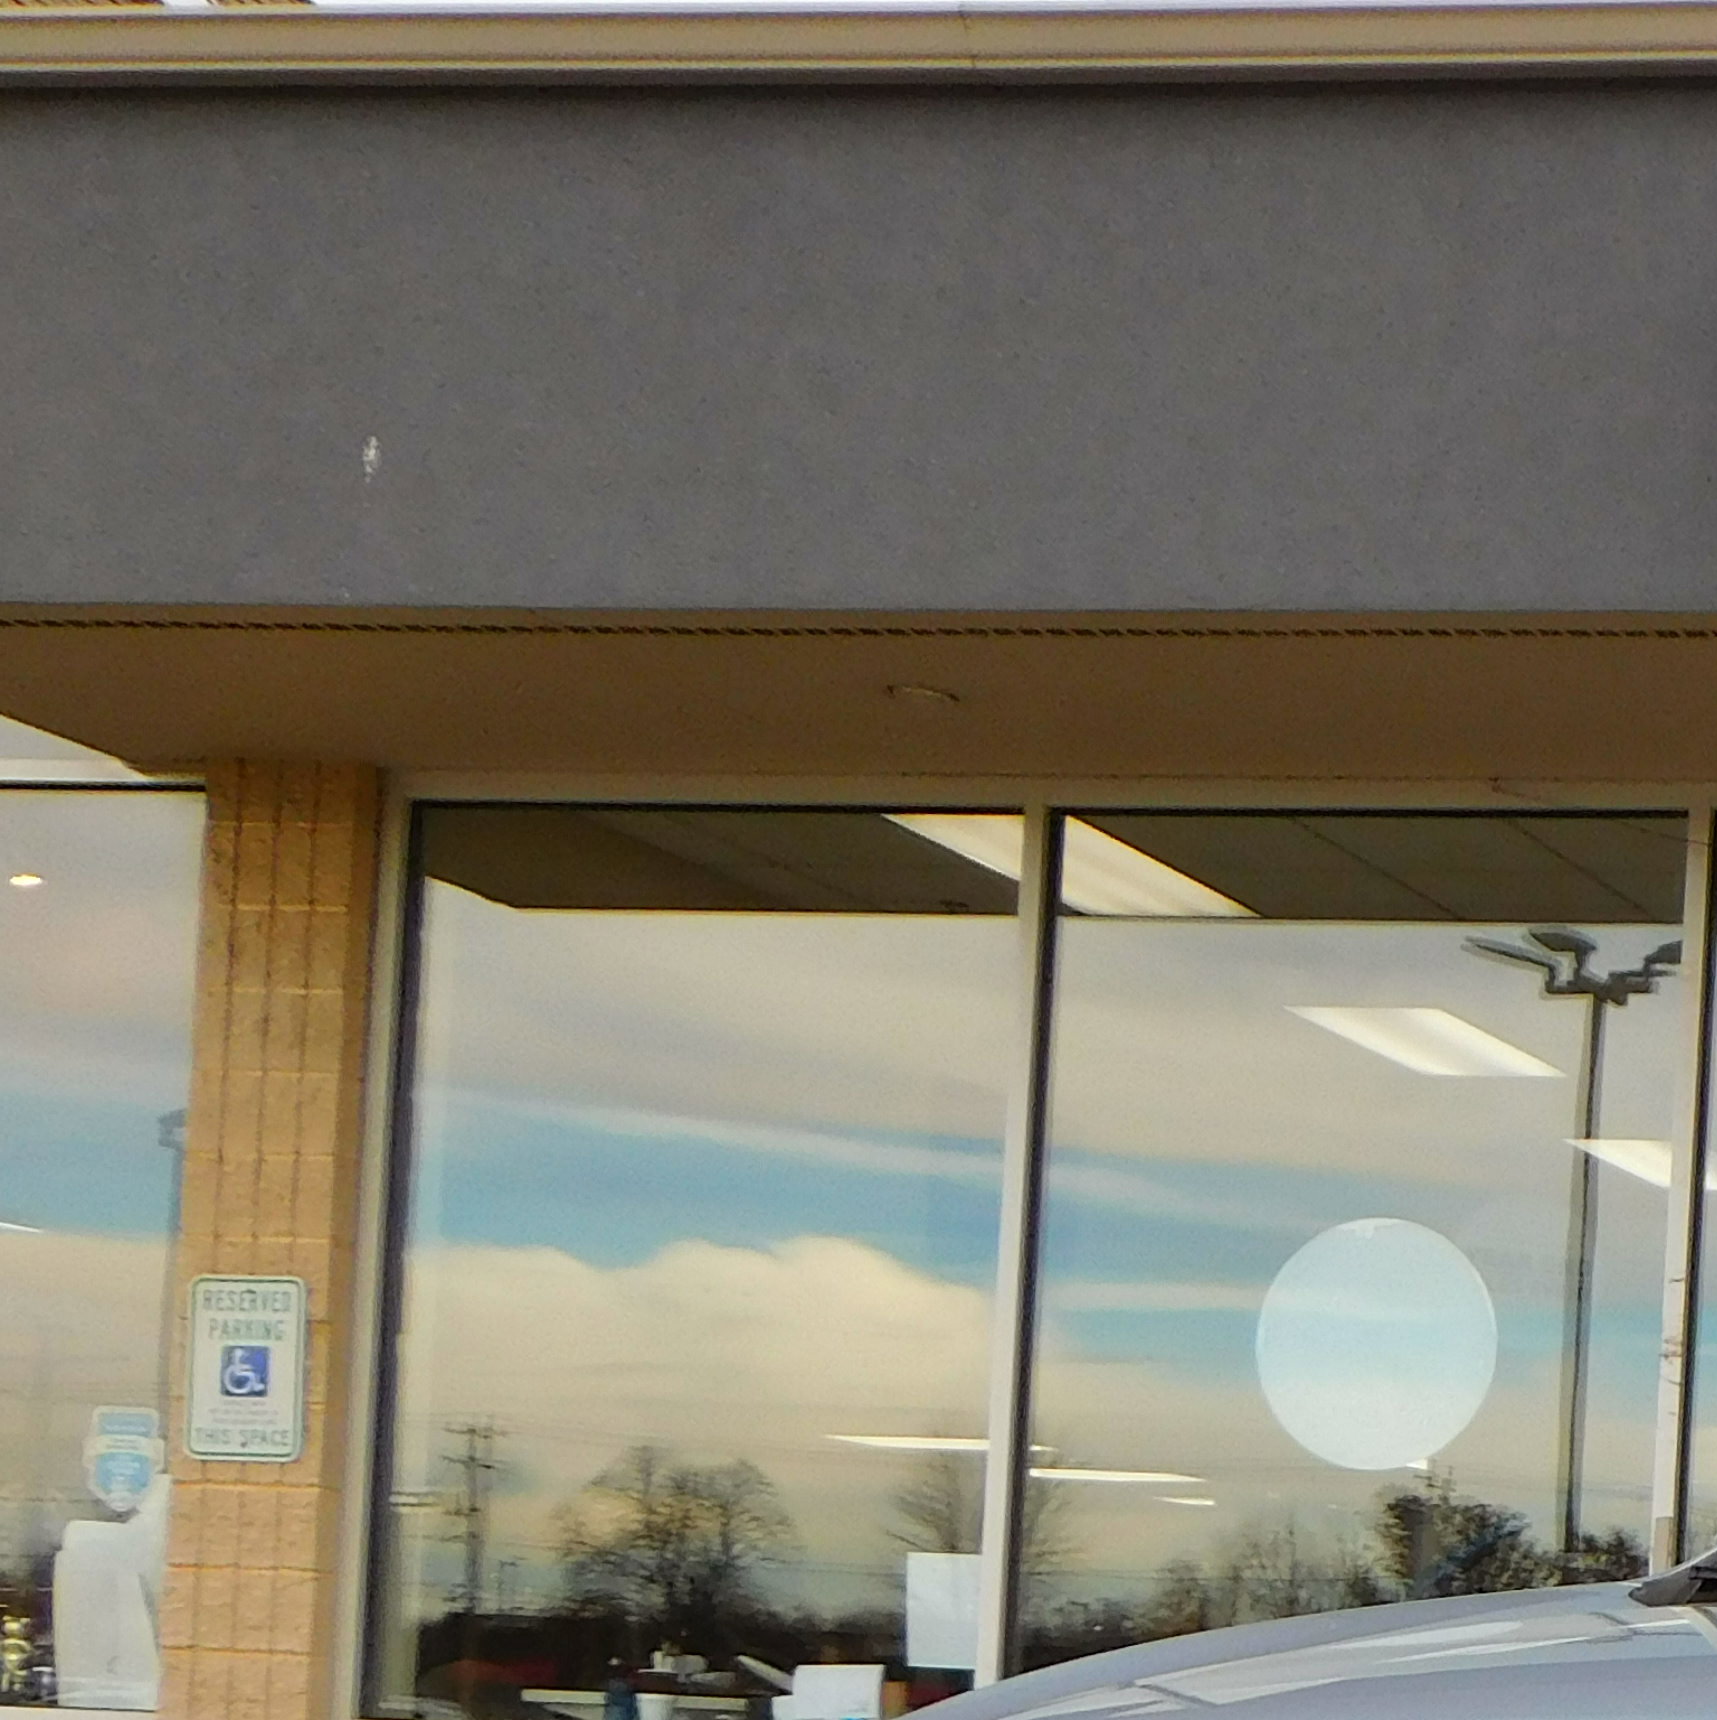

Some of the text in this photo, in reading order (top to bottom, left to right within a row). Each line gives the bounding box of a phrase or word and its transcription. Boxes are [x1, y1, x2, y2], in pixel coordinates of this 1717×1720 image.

[203, 1289, 292, 1312] RESERVED
[208, 1318, 286, 1341] PARKING
[195, 1427, 289, 1447] THIS SPACE
